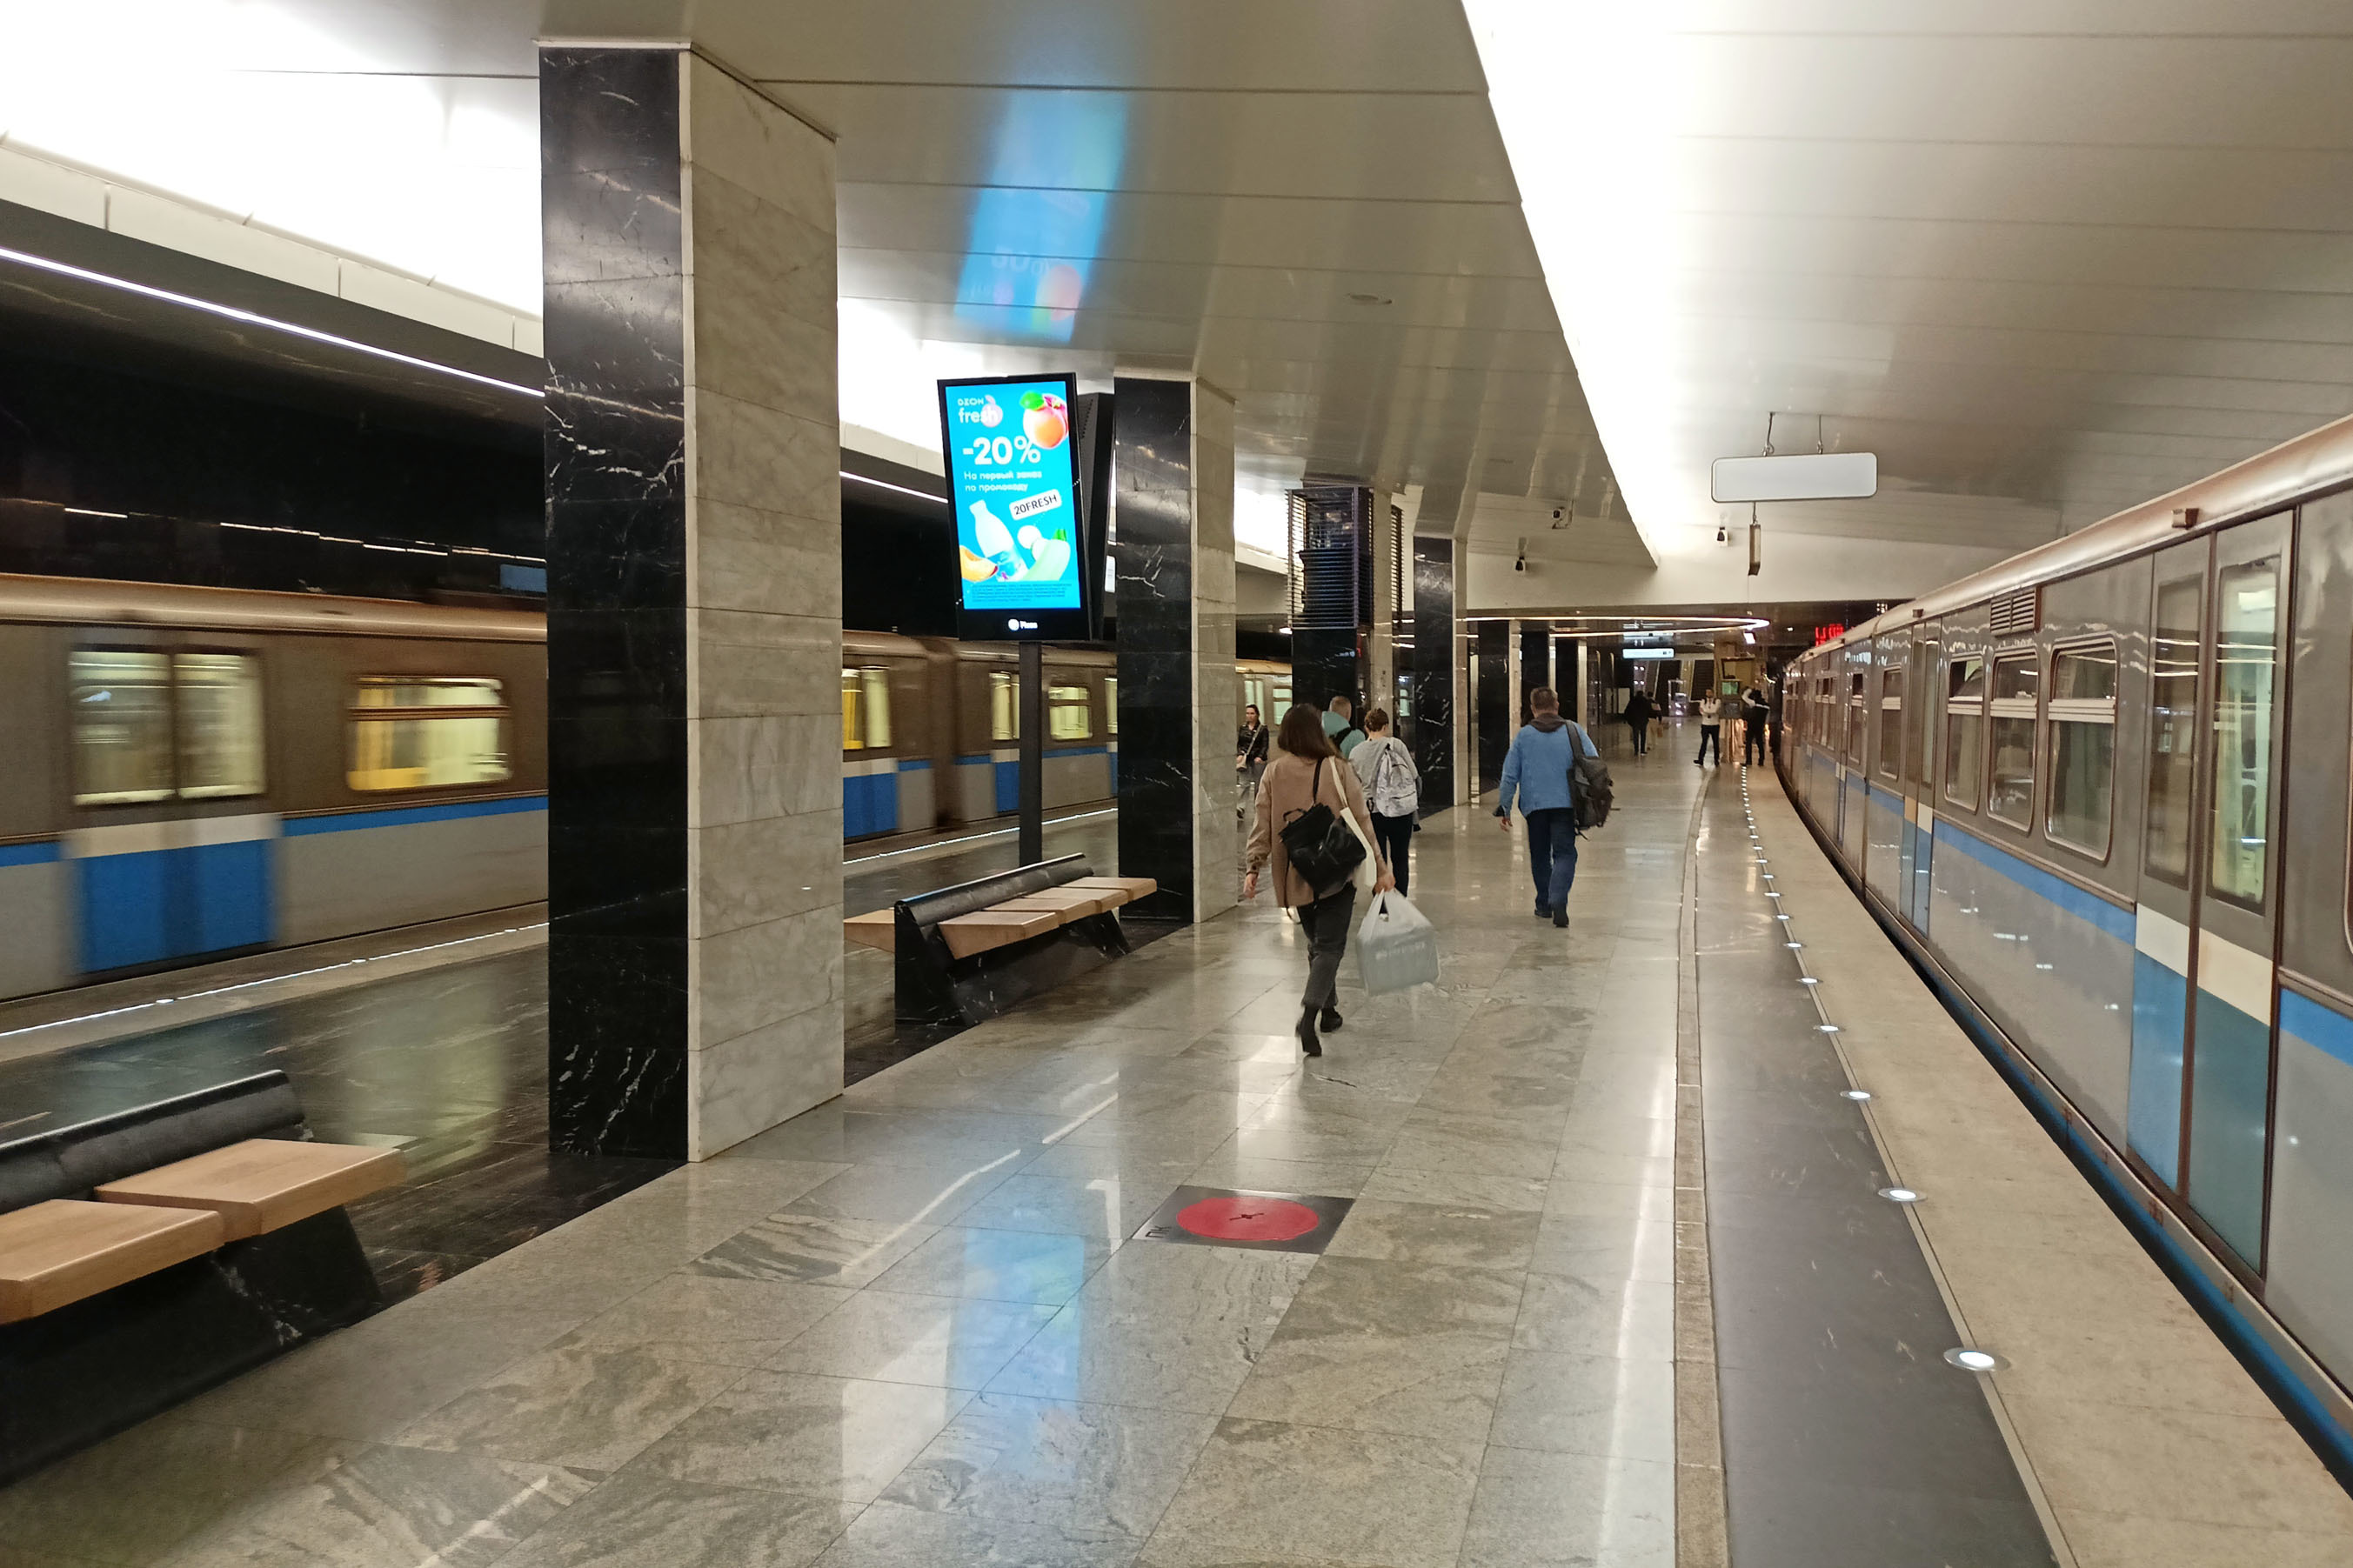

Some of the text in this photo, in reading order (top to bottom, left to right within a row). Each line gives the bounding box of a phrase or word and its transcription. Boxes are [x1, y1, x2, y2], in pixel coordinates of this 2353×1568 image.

[959, 406, 999, 424] fresh
[962, 436, 1041, 465] -20%
[964, 471, 977, 480] На
[1013, 494, 1058, 515] 20FRESH
